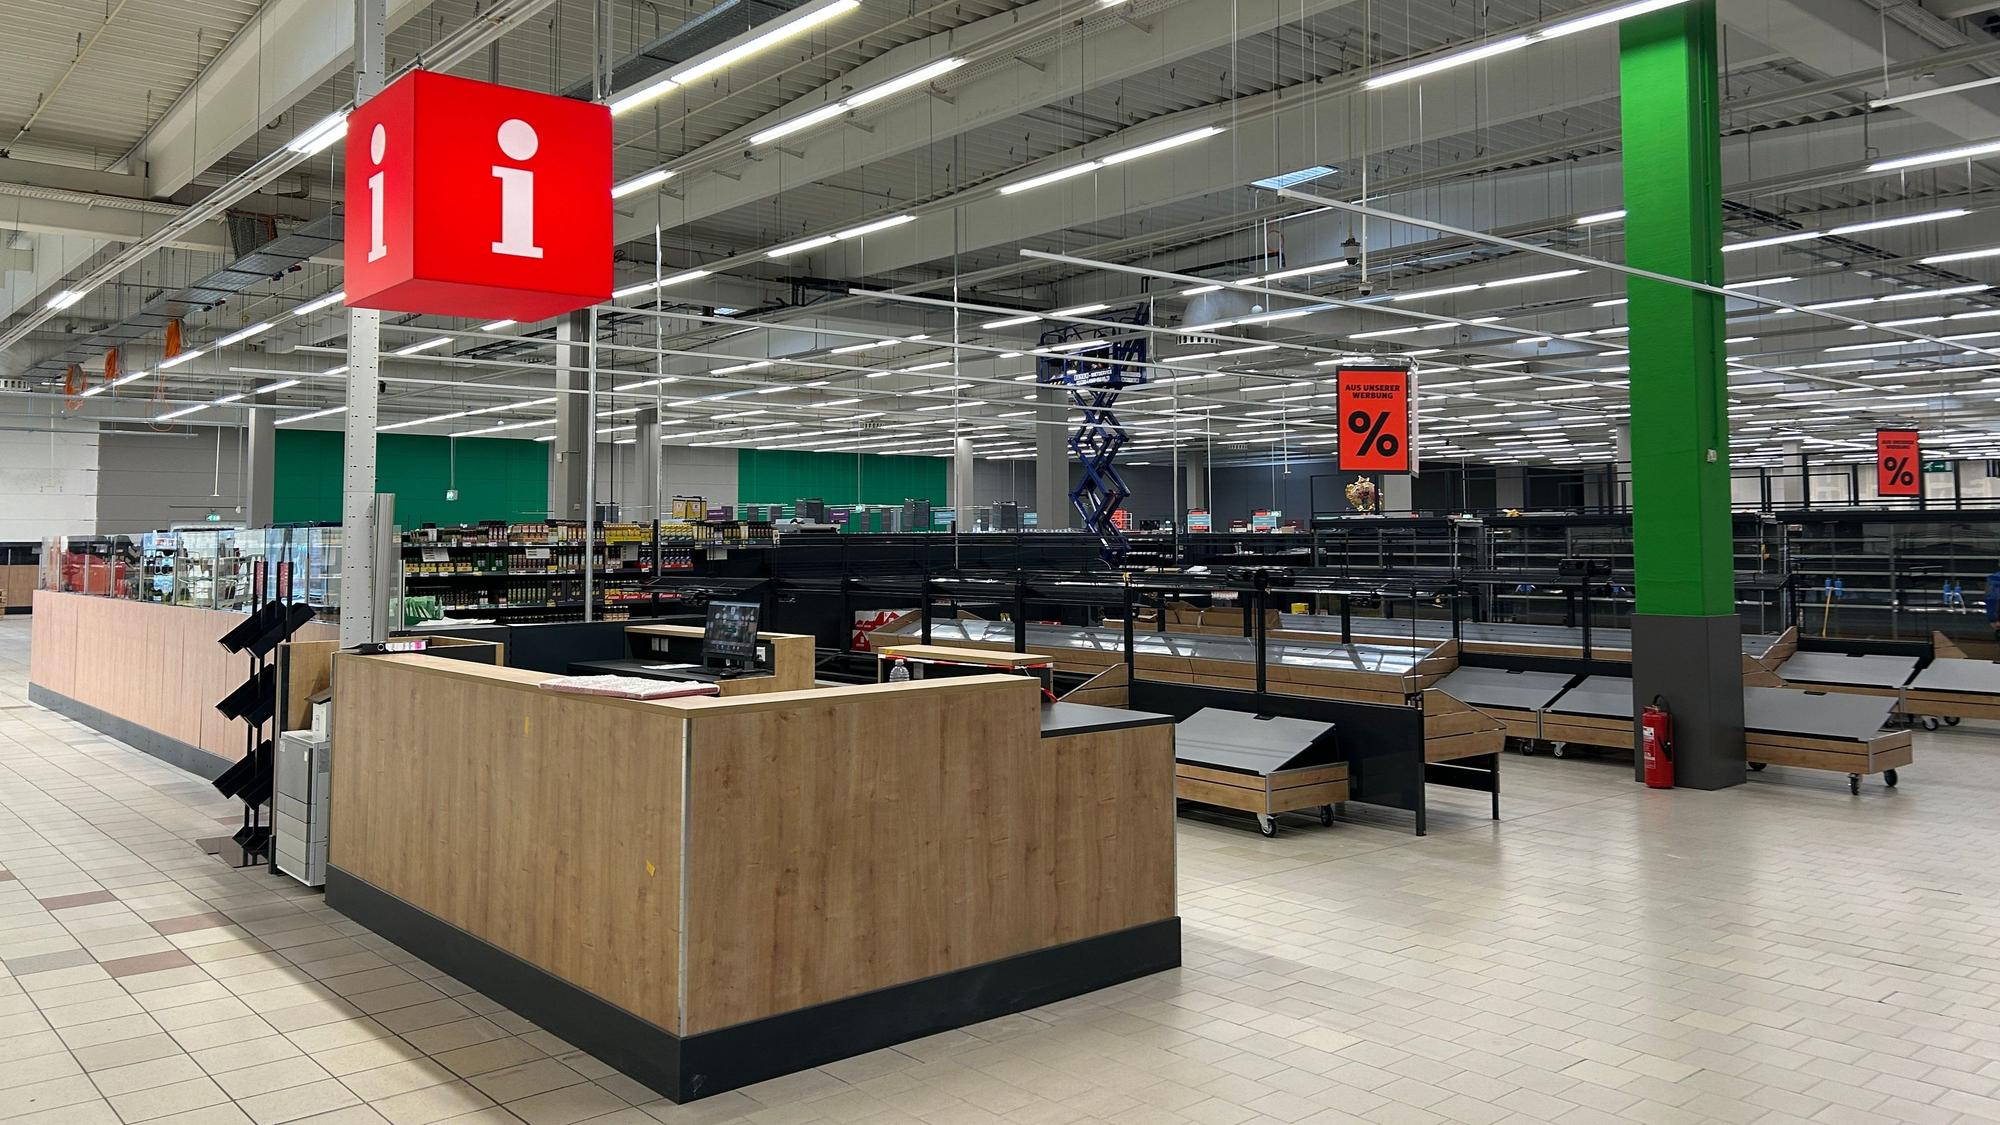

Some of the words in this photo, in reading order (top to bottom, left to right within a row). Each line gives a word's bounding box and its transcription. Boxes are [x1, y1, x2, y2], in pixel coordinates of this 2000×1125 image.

[368, 123, 387, 263] i
[491, 118, 544, 259] i
[1345, 384, 1362, 392] AUS
[1363, 384, 1401, 392] UNSERER
[1348, 410, 1399, 457] %
[1884, 456, 1914, 486] %
